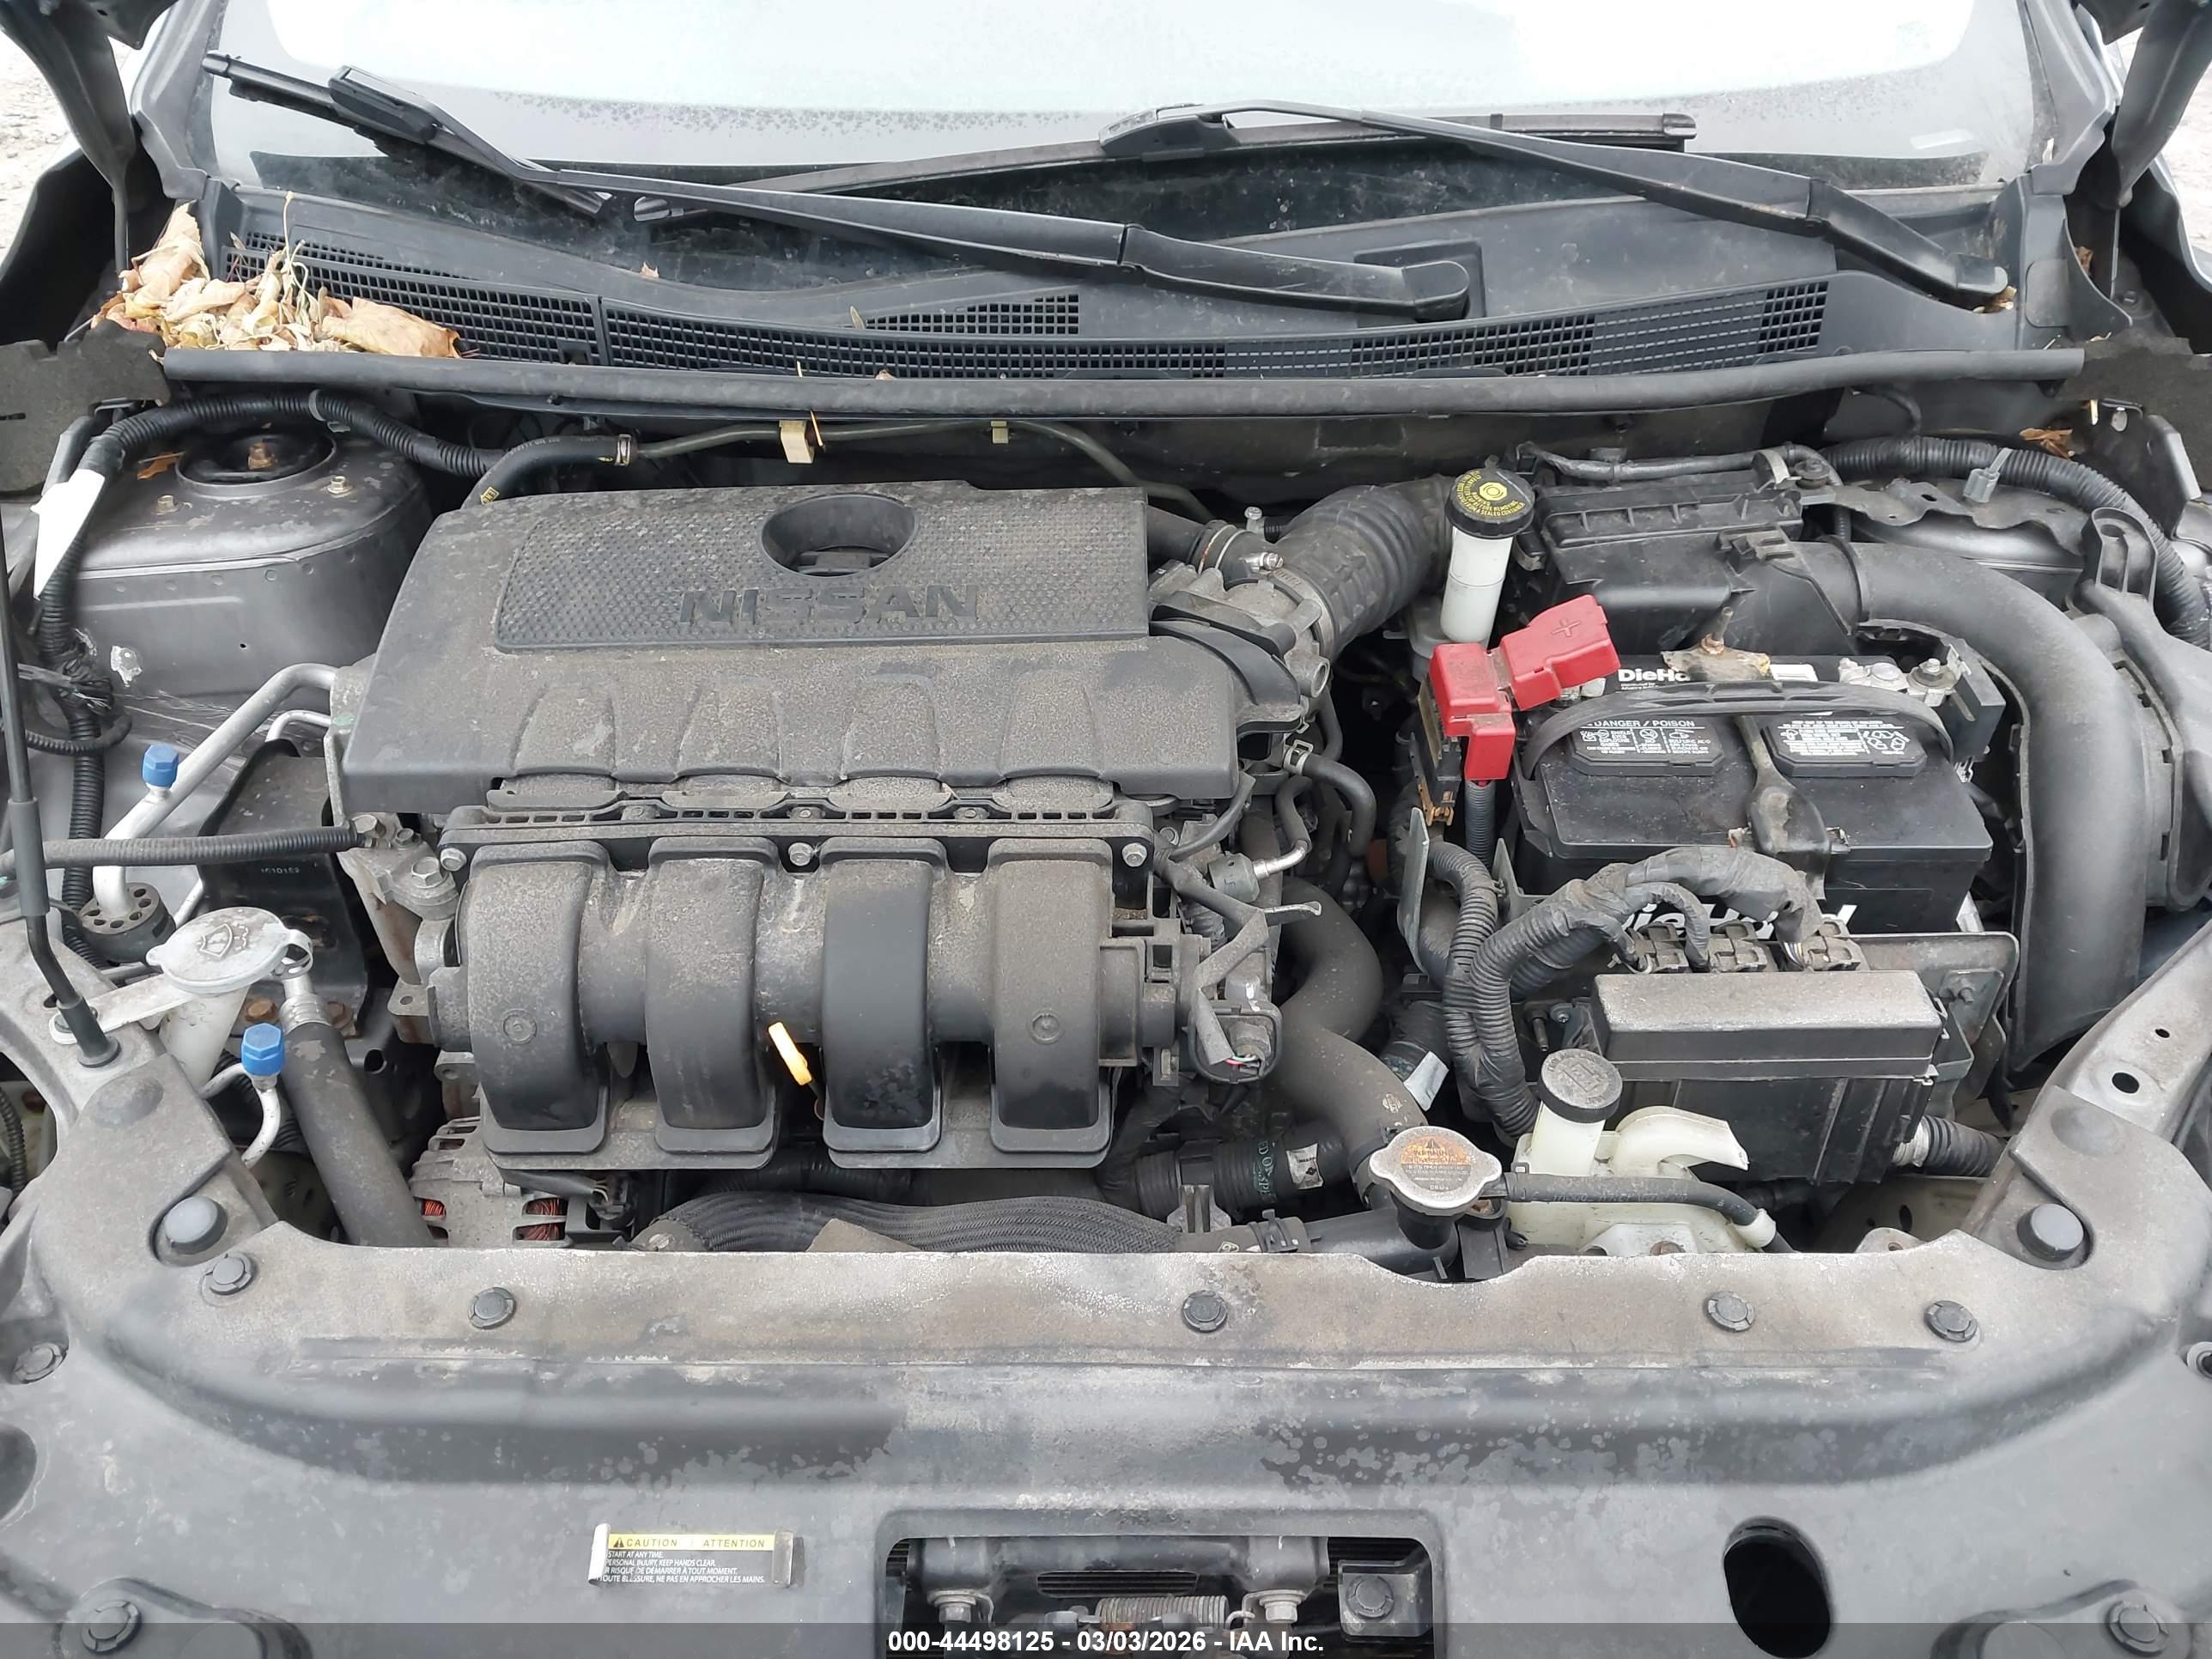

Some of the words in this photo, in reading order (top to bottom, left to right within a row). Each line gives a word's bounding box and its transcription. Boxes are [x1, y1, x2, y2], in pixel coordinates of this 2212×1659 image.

[680, 585, 978, 625] NISSAN
[1618, 668, 1691, 682] DieHa
[626, 1538, 678, 1547] CAUTION
[703, 1539, 765, 1547] ATTENTION
[696, 1559, 716, 1567] CLEAR.
[730, 1575, 742, 1583] LES
